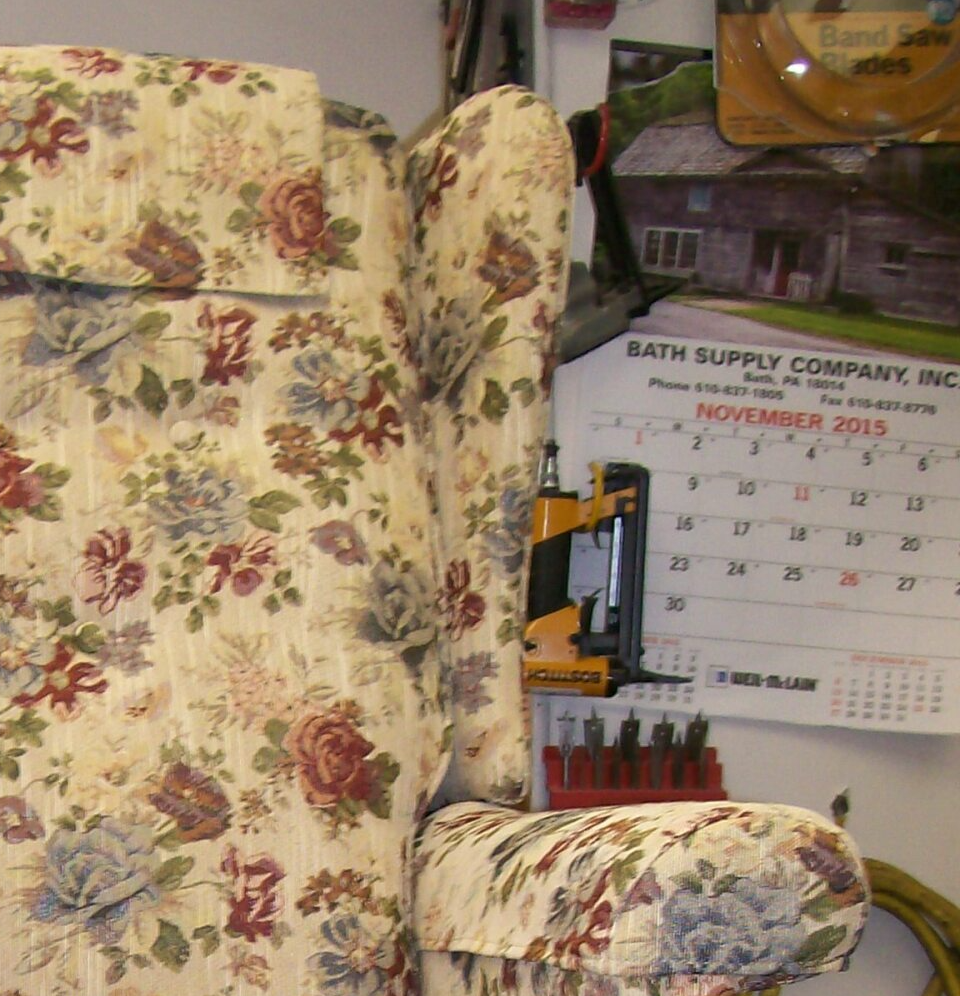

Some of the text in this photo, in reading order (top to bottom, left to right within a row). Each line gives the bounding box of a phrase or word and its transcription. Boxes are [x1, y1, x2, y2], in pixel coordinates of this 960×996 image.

[819, 23, 952, 47] Band Saw
[819, 52, 912, 76] Blades
[626, 340, 687, 362] BATH
[694, 346, 783, 371] SUPPLY
[790, 356, 910, 386] COMPANY,
[648, 377, 690, 391] Phone
[820, 393, 843, 406] Fax
[782, 375, 800, 388] PA
[696, 402, 889, 437] NOVEMBER 2015
[635, 430, 929, 472] 1 2 3 4 5 6
[687, 476, 925, 512] 9 10 11 12 13
[675, 516, 921, 552] 16 17 18 19 20
[669, 556, 917, 592] 23 24 25 26 27
[664, 596, 686, 612] 30
